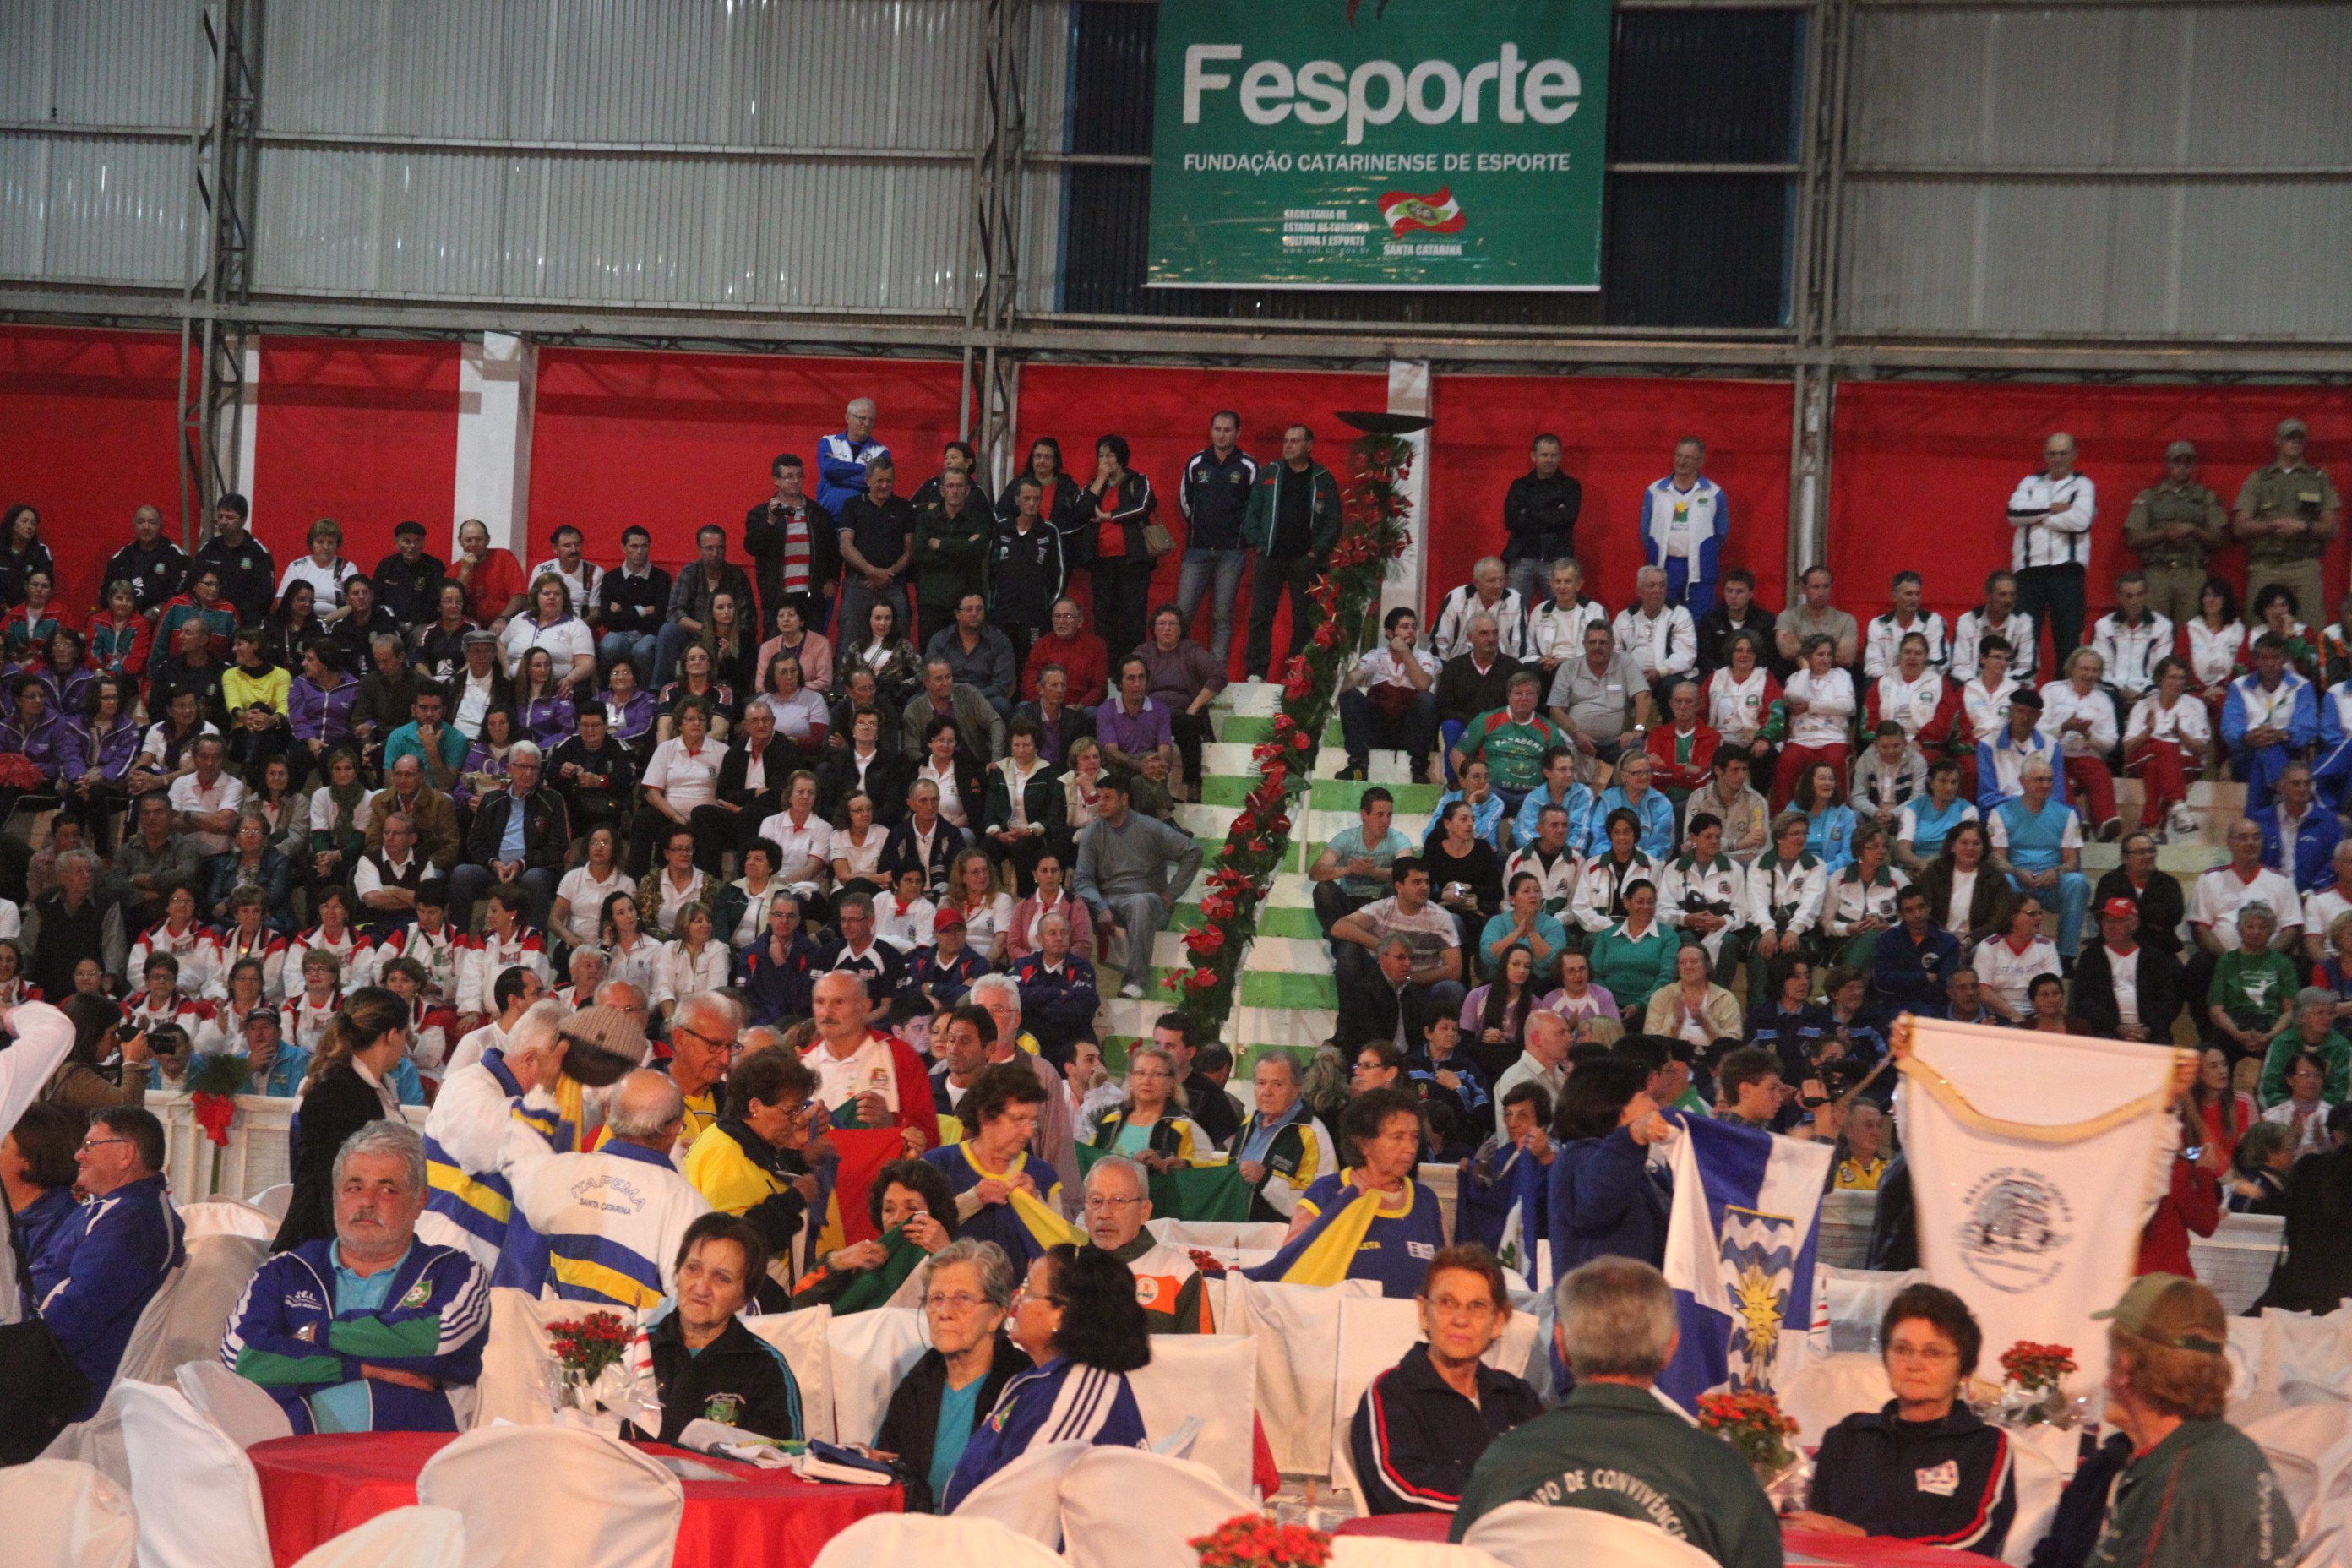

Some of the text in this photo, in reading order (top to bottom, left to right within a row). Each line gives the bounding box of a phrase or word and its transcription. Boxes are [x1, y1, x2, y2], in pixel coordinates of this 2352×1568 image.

[1183, 42, 1581, 146] Fesporte
[1184, 150, 1571, 176] FUNDAÇÃO CATARINENSE DE ESPORTE
[1283, 222, 1315, 232] ESTADO
[1328, 236, 1366, 246] ESPORTE
[1383, 244, 1462, 256] SANTA CATARINA
[570, 1175, 646, 1212] ITAPEMA
[580, 1198, 599, 1208] SANTA
[1564, 1469, 1587, 1493] DE
